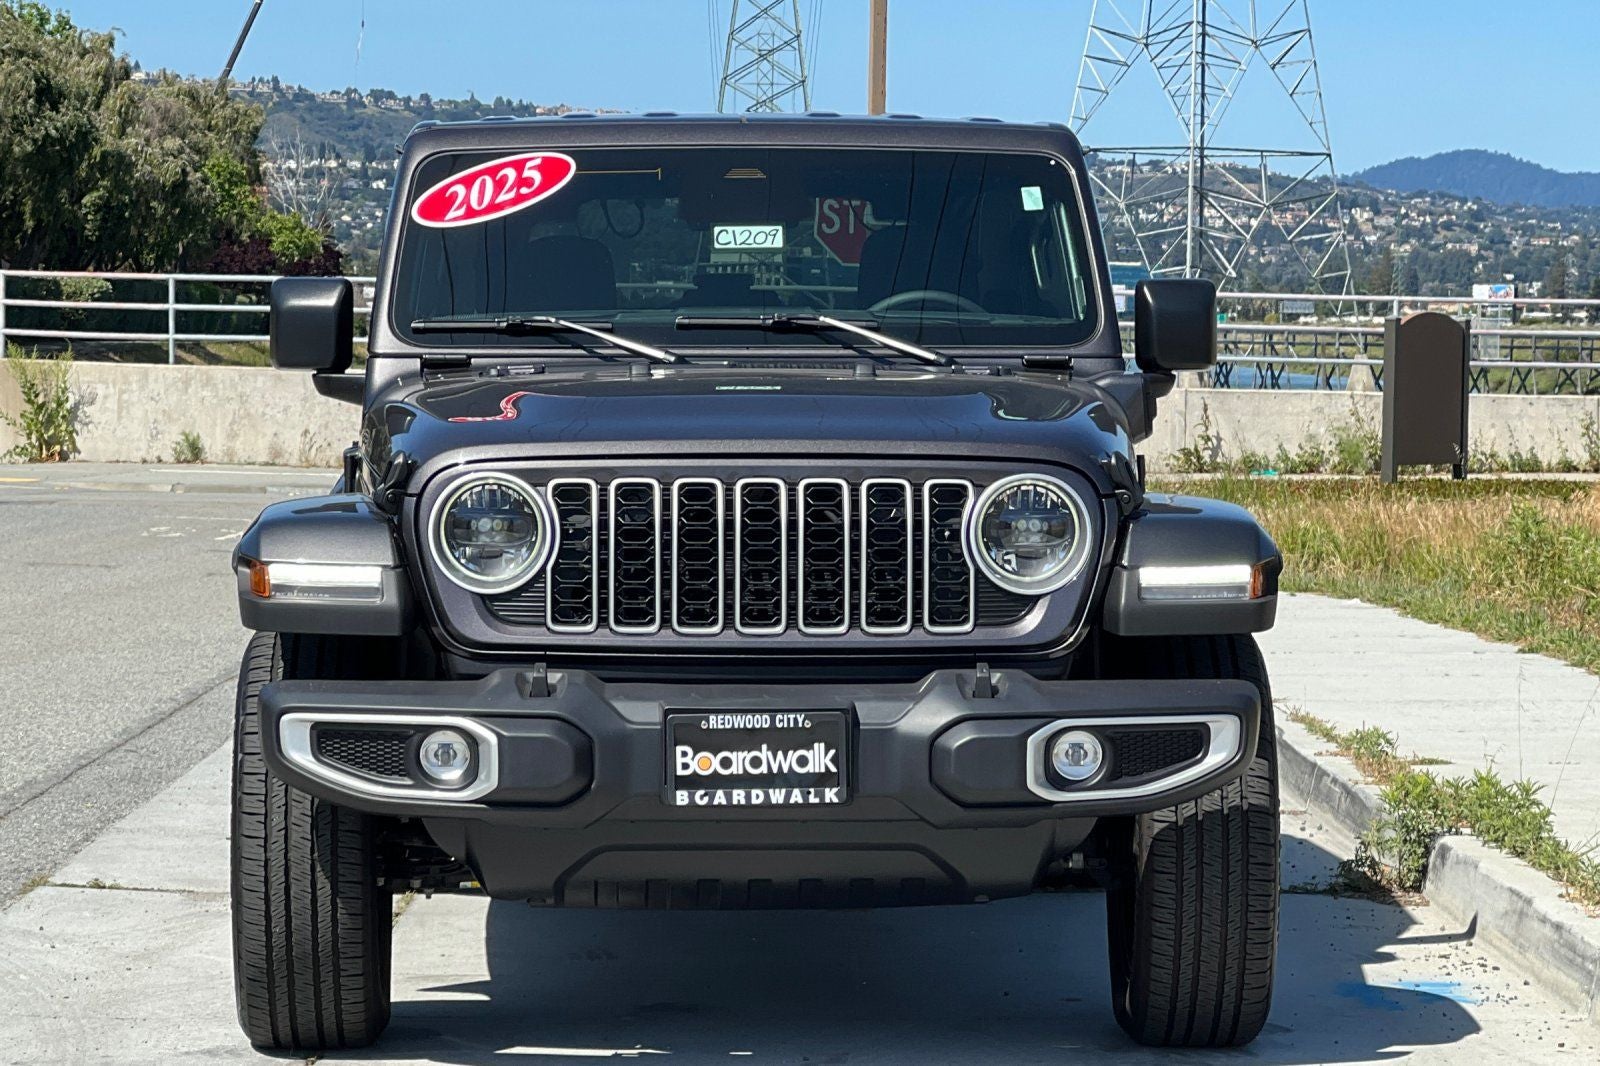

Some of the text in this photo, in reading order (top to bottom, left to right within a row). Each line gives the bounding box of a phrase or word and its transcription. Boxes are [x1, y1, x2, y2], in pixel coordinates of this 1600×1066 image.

[444, 157, 542, 221] 2025
[709, 713, 805, 730] REDWOOD CITY
[675, 742, 838, 776] Boardwalk
[675, 787, 840, 806] BOARDWALK
